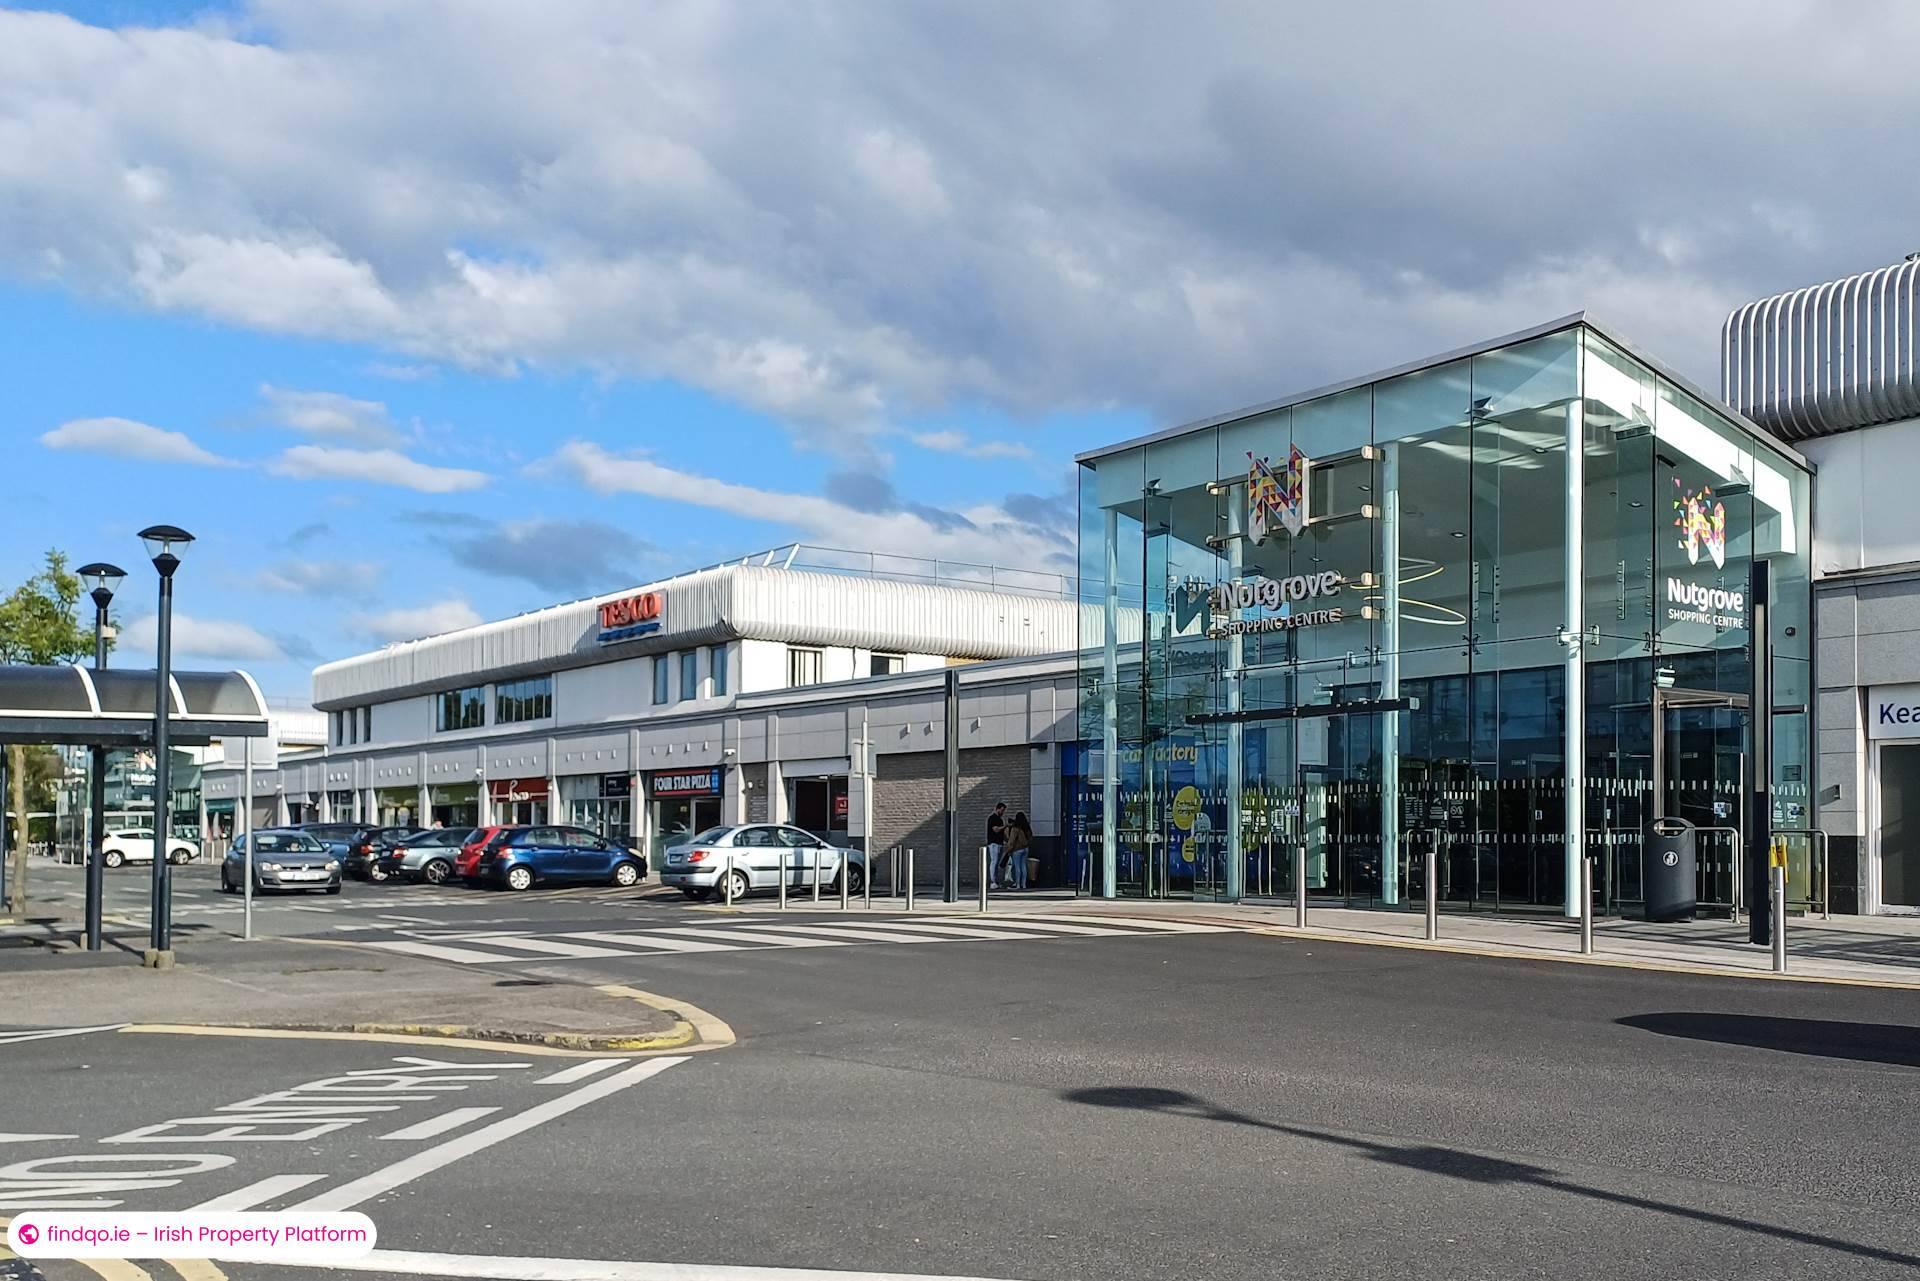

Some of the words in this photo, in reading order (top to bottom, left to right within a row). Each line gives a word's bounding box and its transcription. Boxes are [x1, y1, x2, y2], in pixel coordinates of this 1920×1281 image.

[1220, 570, 1341, 611] Nutgrove
[1667, 577, 1744, 612] Nutgrove
[598, 592, 662, 628] TESCO
[1222, 616, 1283, 637] SHOPPING
[1287, 608, 1342, 629] CENTRE
[1668, 608, 1711, 625] SHOPPING
[1713, 614, 1744, 629] CENTRE
[654, 776, 673, 791] FOUR
[673, 775, 692, 790] STAR
[692, 774, 711, 789] PIZZA
[98, 1056, 534, 1143] ENTRY
[0, 1153, 237, 1210] NO
